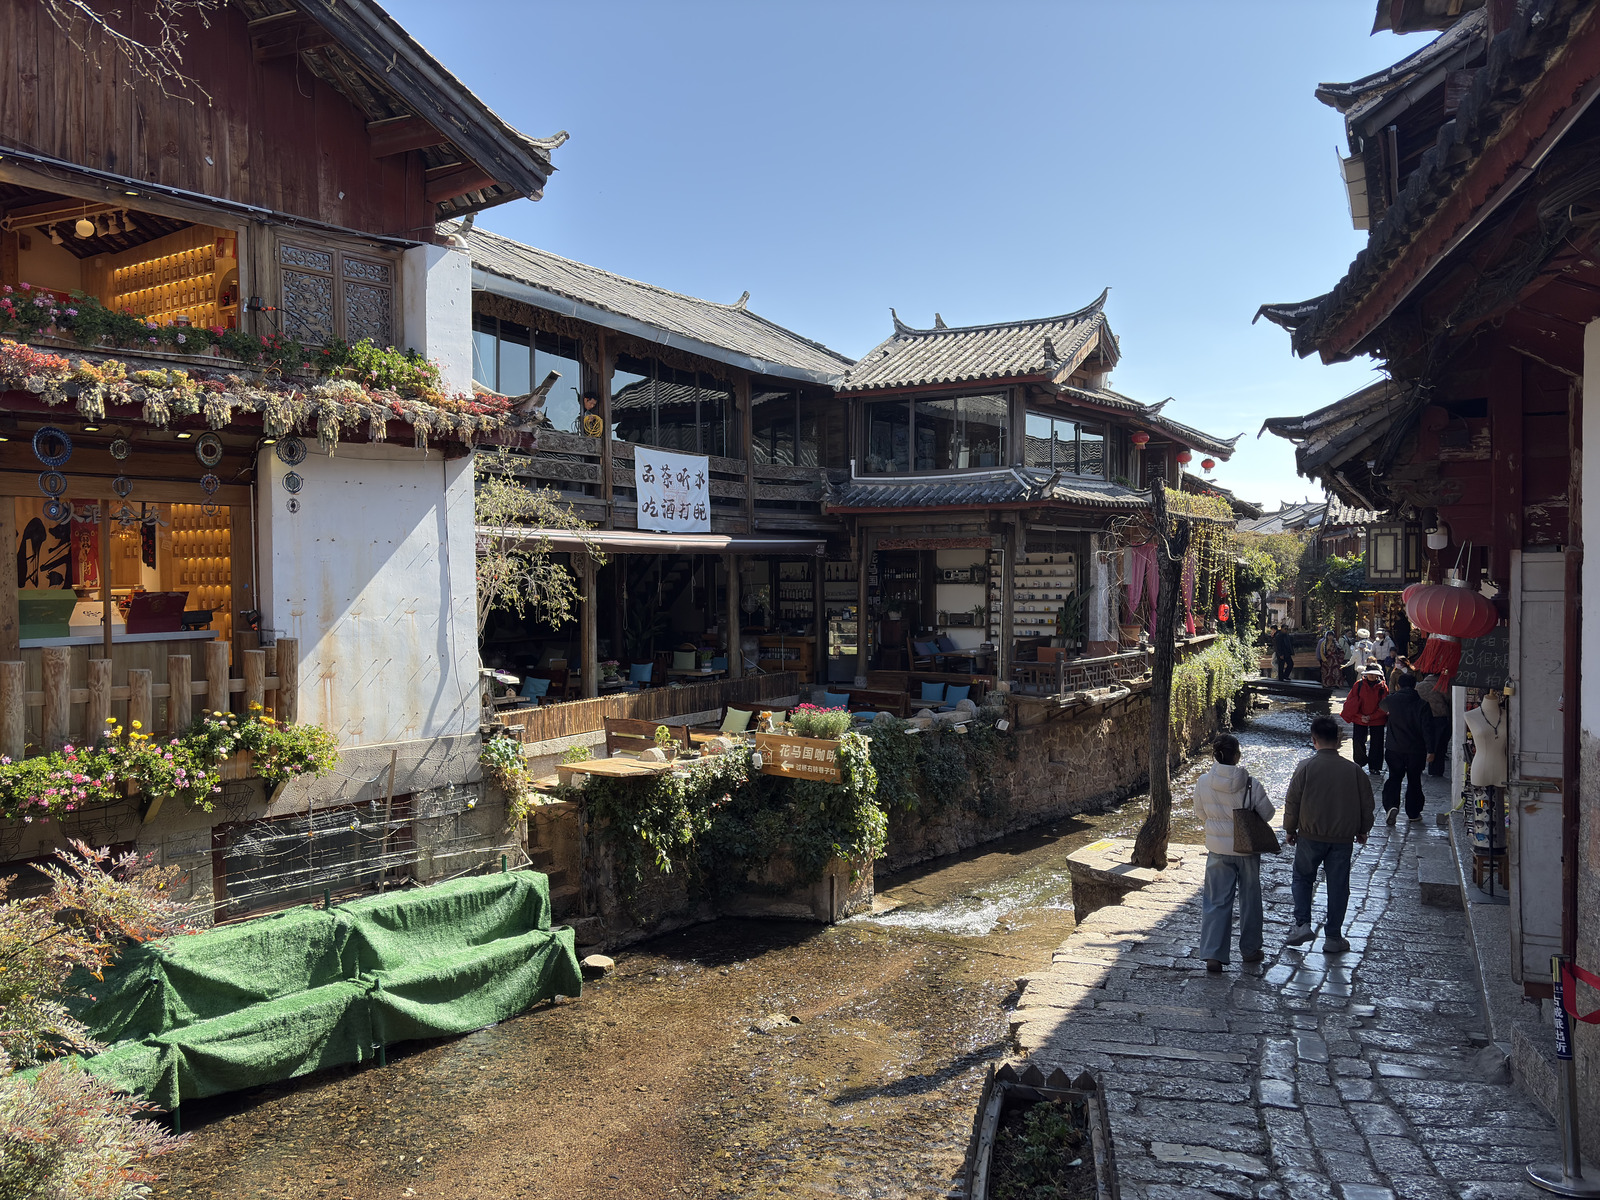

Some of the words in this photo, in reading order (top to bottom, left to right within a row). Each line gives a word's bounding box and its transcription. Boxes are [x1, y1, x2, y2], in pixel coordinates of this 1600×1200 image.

[642, 464, 706, 491] 品茶听水
[780, 744, 837, 763] 花马国咖啡
